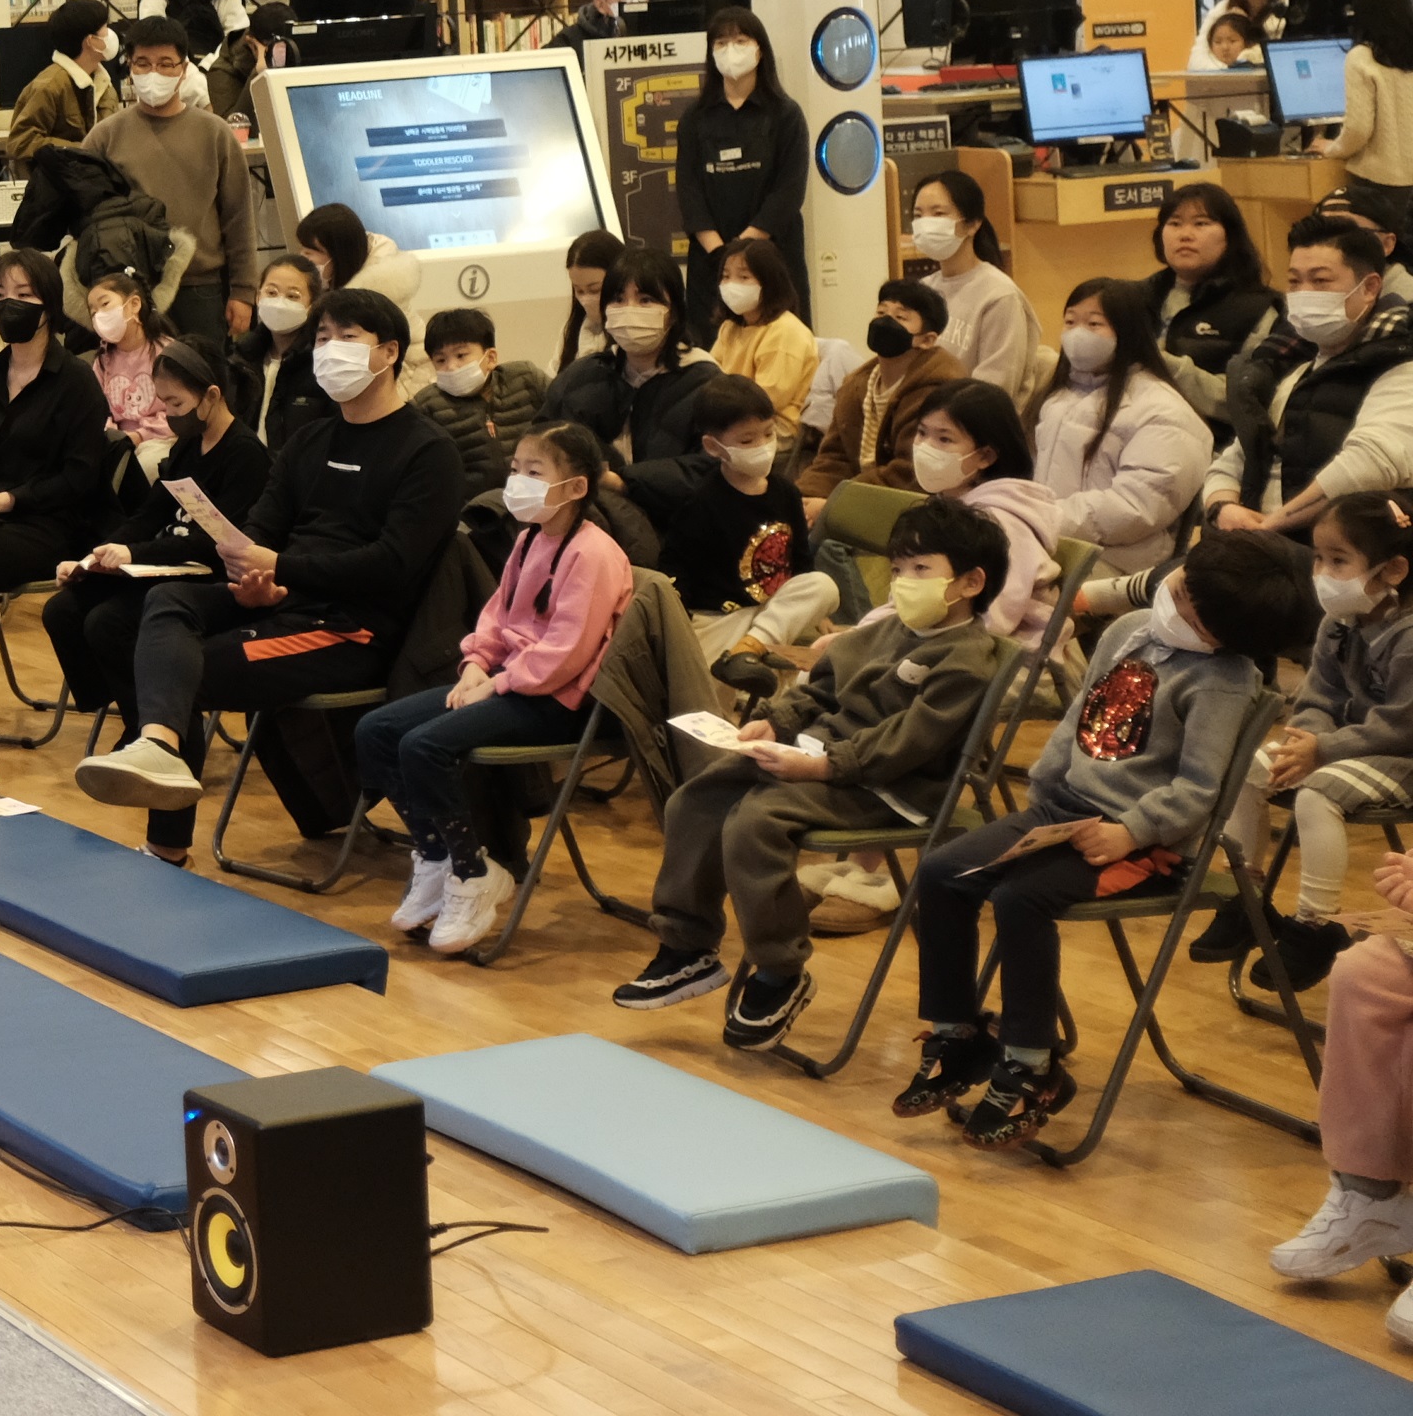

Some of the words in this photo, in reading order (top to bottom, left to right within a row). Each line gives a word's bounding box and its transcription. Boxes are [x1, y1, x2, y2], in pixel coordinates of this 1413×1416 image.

[604, 42, 678, 62] 서가배치도
[616, 77, 632, 92] 2F
[338, 89, 383, 102] HEADLINE
[413, 157, 443, 167] TODDLER
[444, 155, 473, 165] RESCUED
[622, 170, 638, 185] 3F
[1114, 188, 1138, 205] 도서
[1140, 186, 1164, 203] 검색
